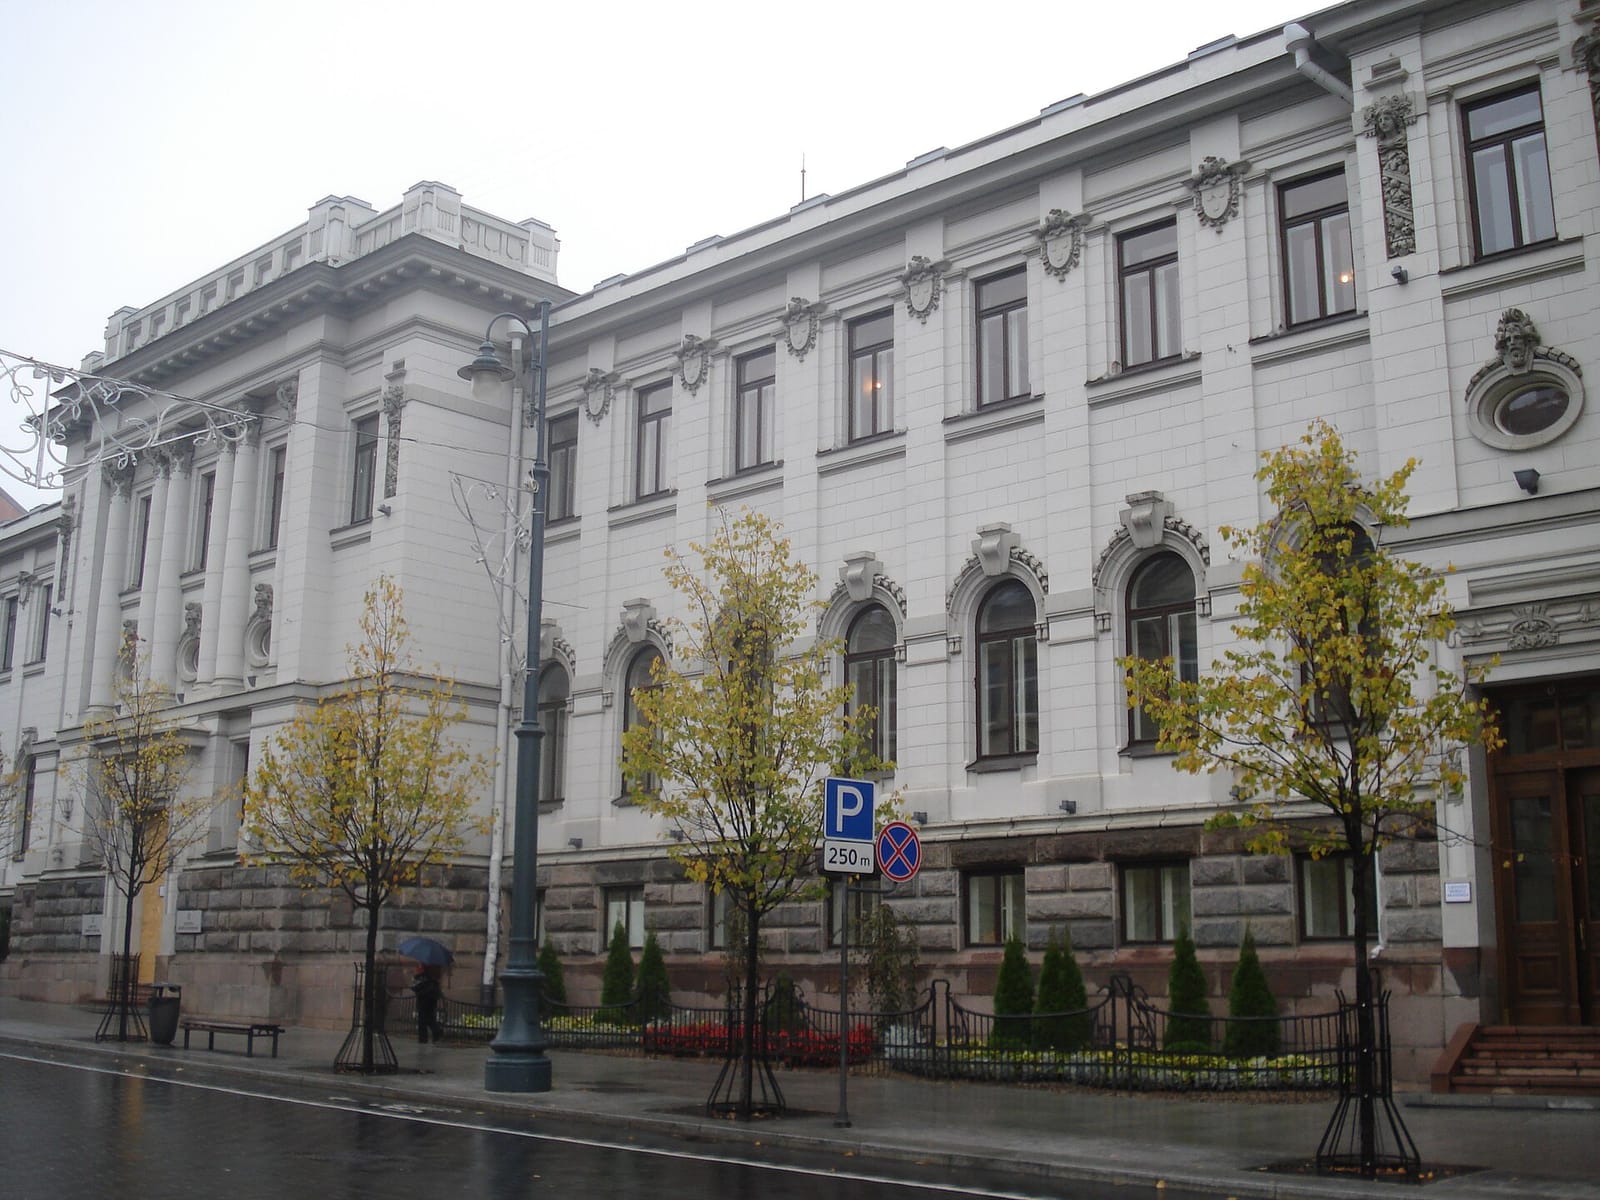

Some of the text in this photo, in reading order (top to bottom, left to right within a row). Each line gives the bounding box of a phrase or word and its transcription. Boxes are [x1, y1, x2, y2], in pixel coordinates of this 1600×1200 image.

[836, 785, 864, 832] P
[828, 847, 870, 866] 250 m
